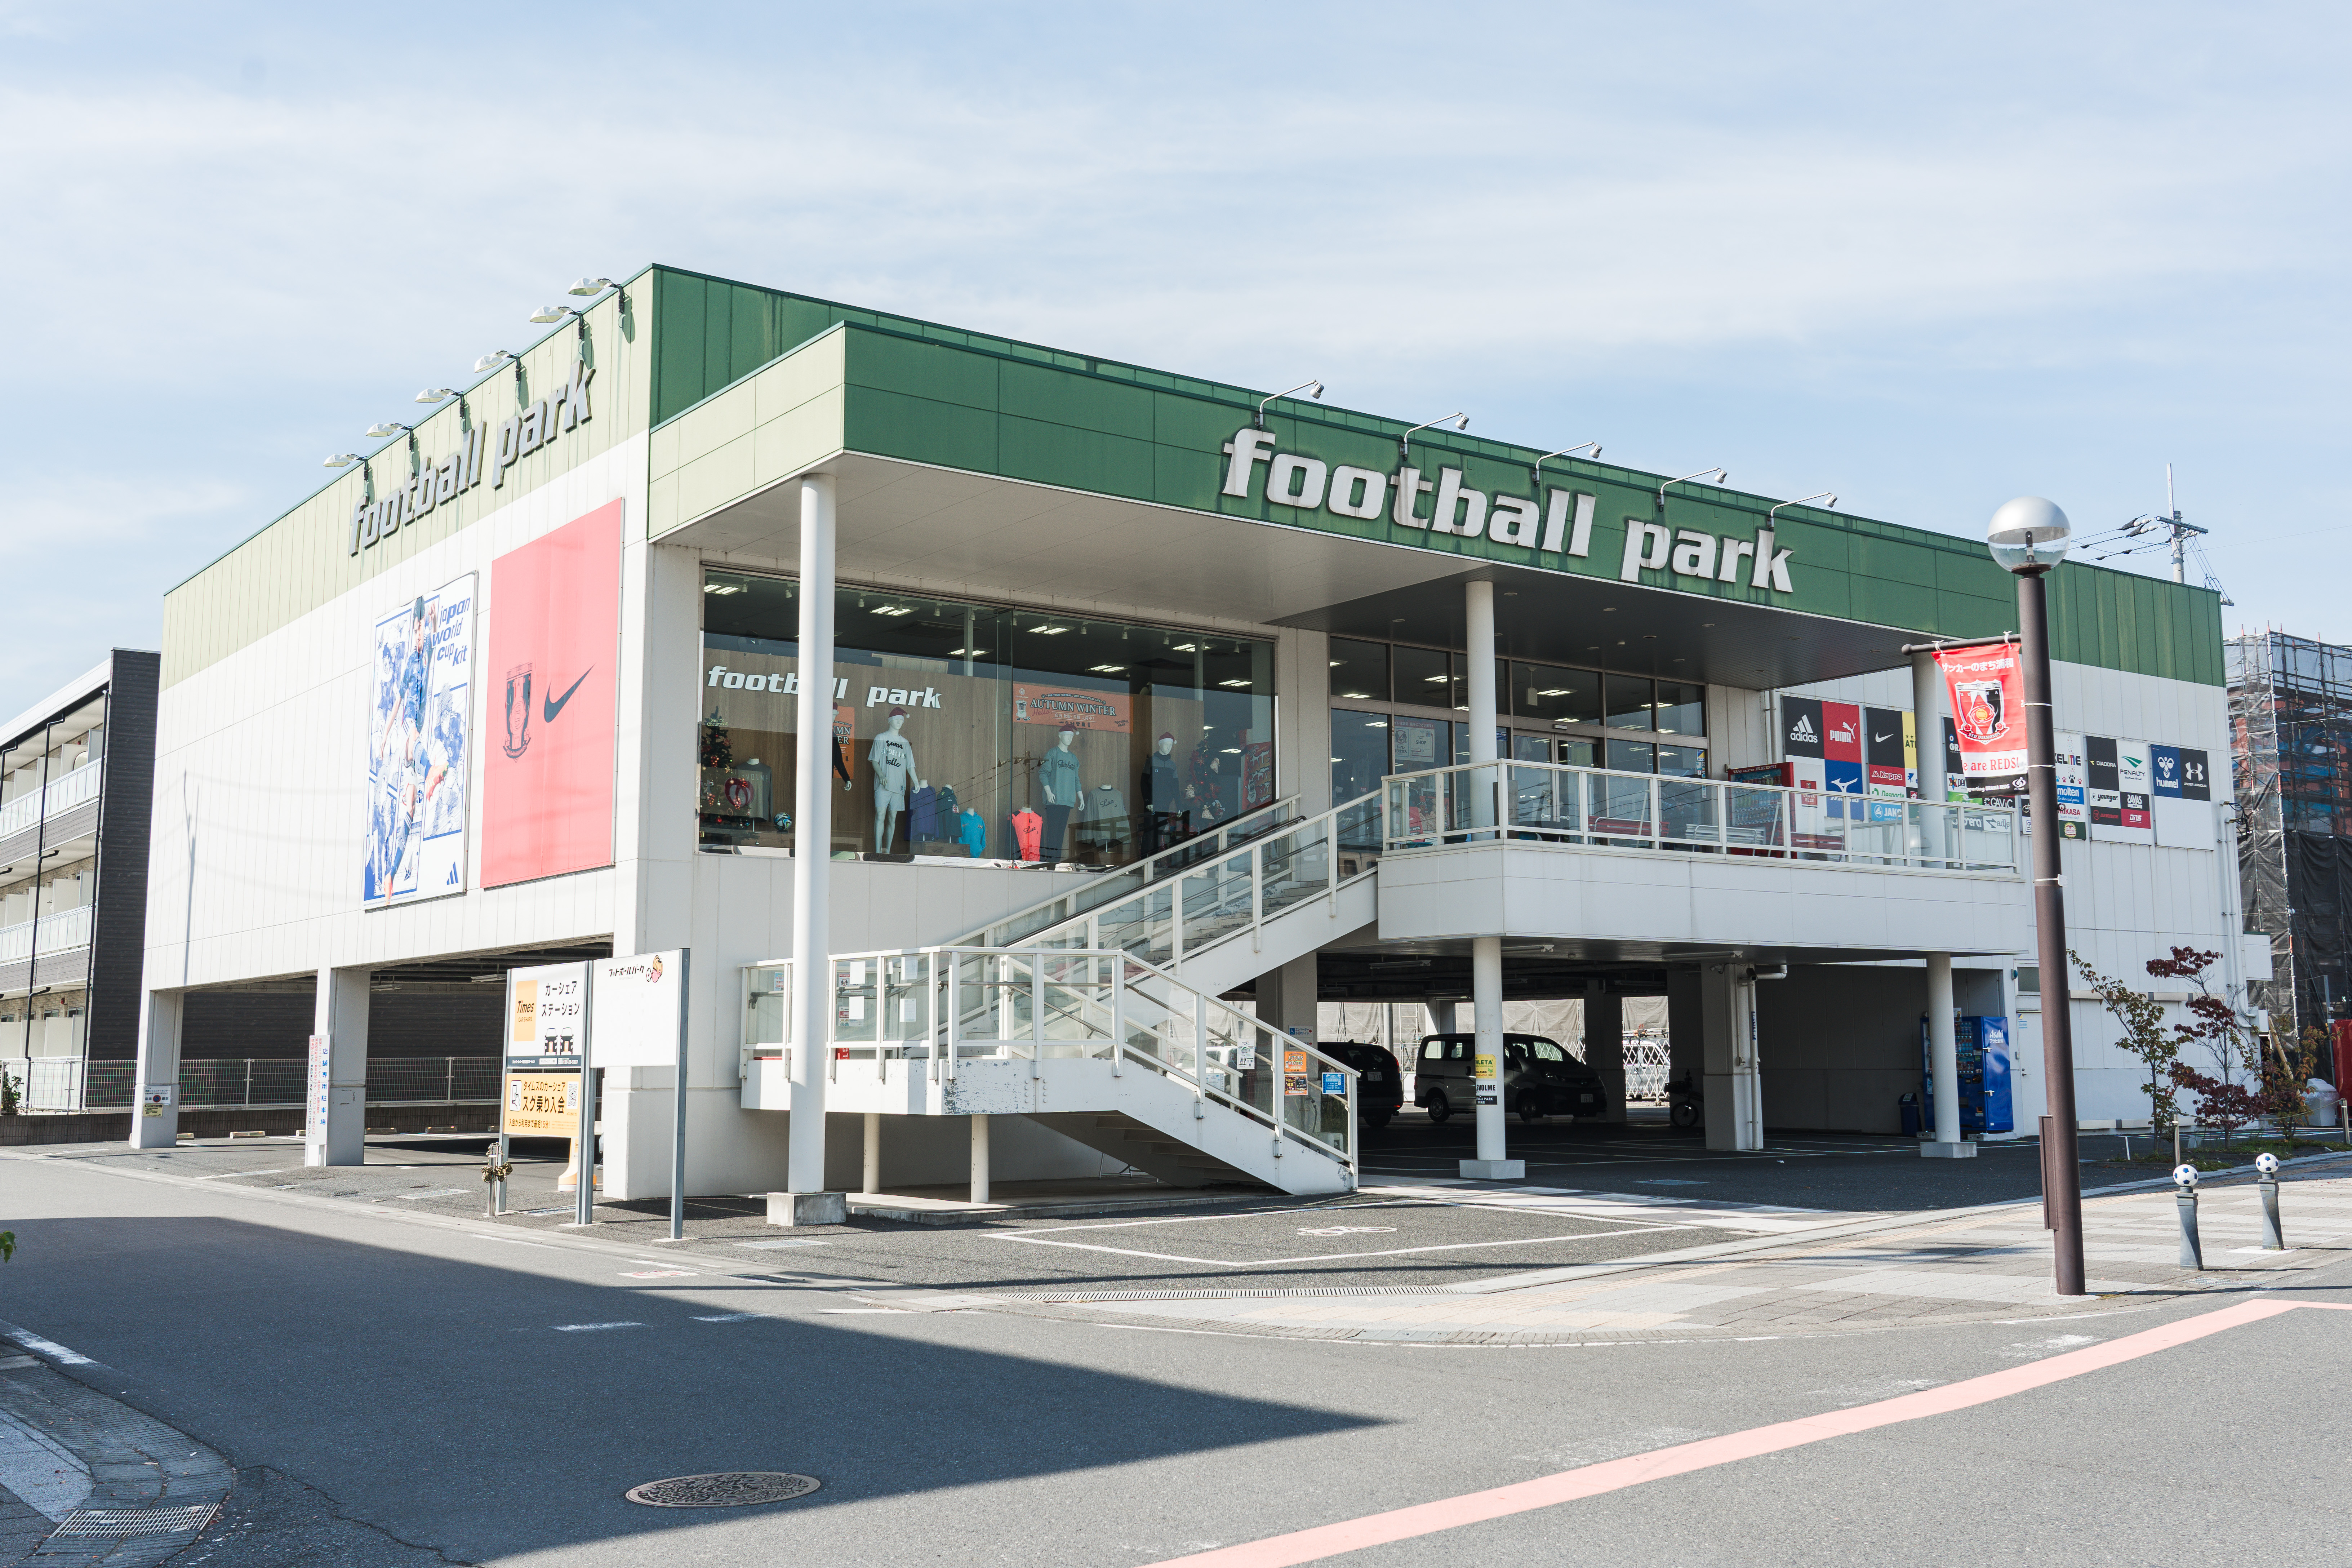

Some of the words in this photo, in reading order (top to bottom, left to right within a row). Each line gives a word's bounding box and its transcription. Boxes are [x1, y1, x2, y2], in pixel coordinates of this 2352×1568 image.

[349, 421, 486, 558] football
[492, 360, 596, 490] park
[1221, 427, 1596, 558] football
[1620, 519, 1795, 594] park
[439, 597, 470, 628] japan
[432, 617, 463, 647] world
[437, 643, 454, 661] cup
[452, 645, 467, 666] kit
[1942, 657, 2014, 673] サッカーのまち浦和
[707, 666, 848, 699] footbll
[866, 686, 942, 709] park
[1030, 698, 1074, 712] AUTUMN
[1076, 702, 1116, 716] WINTER
[1790, 731, 1818, 743] adidas
[1830, 730, 1851, 743] PUMA
[1971, 762, 1987, 771] are
[1990, 757, 2019, 770] REDS!
[1880, 771, 1903, 781] Kappa
[2156, 776, 2179, 789] hummel
[2057, 787, 2080, 797] molten
[609, 964, 644, 977] フットボールパーク
[545, 981, 577, 996] カーシェア
[517, 1000, 534, 1013] Times
[542, 1003, 580, 1017] ステーション
[1989, 1029, 2004, 1038] Asahi
[320, 1048, 328, 1125] 店舗専用駐車場
[524, 1081, 566, 1092] タイムズのカーシェア
[523, 1096, 565, 1114] スグ乗り入会
[508, 1118, 550, 1129] 入会から利用まで最短15分!
